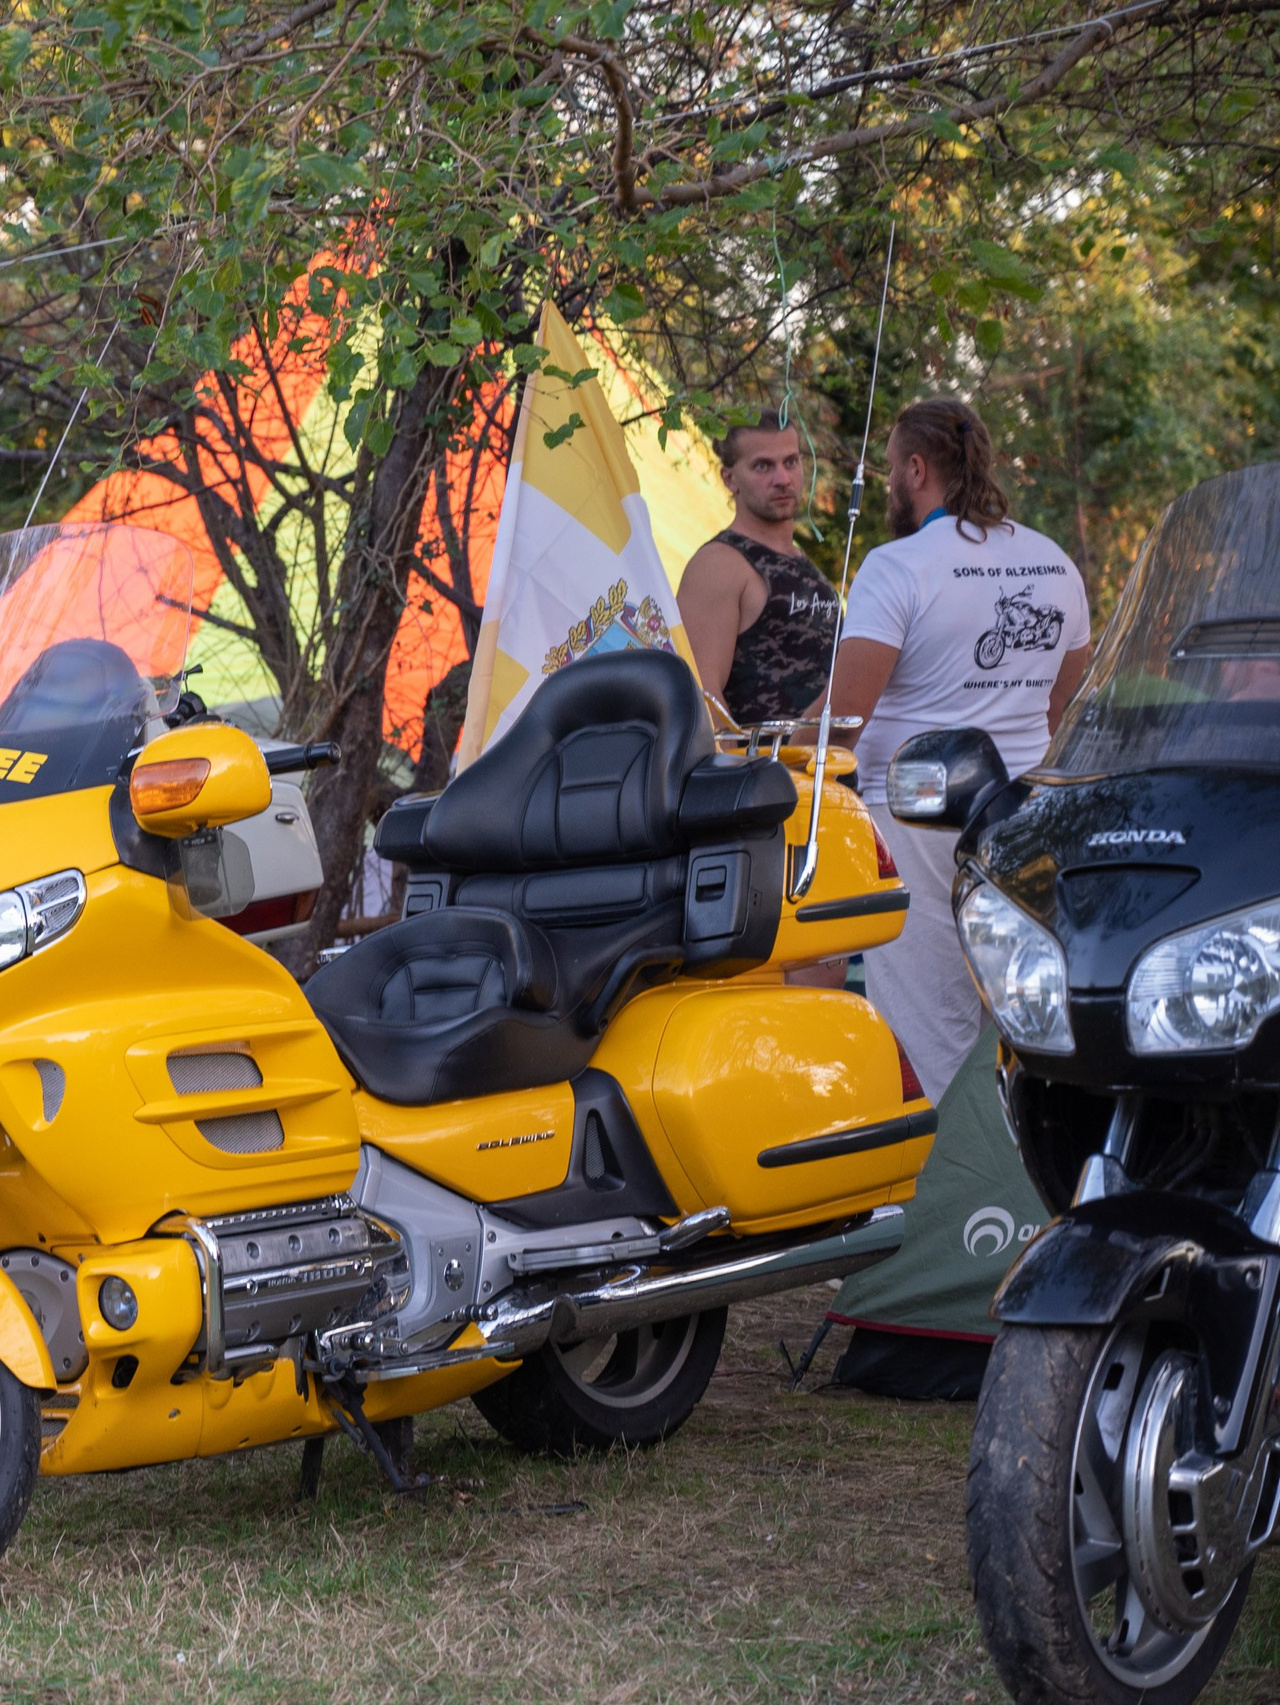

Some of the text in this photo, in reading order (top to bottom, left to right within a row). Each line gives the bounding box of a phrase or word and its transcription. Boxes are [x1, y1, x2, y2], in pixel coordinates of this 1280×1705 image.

[953, 564, 1068, 578] SONS OF ALZHEIMER
[789, 591, 809, 617] Los
[963, 678, 1054, 690] WHERE'S MY BIKE???
[1087, 829, 1187, 847] HONDA
